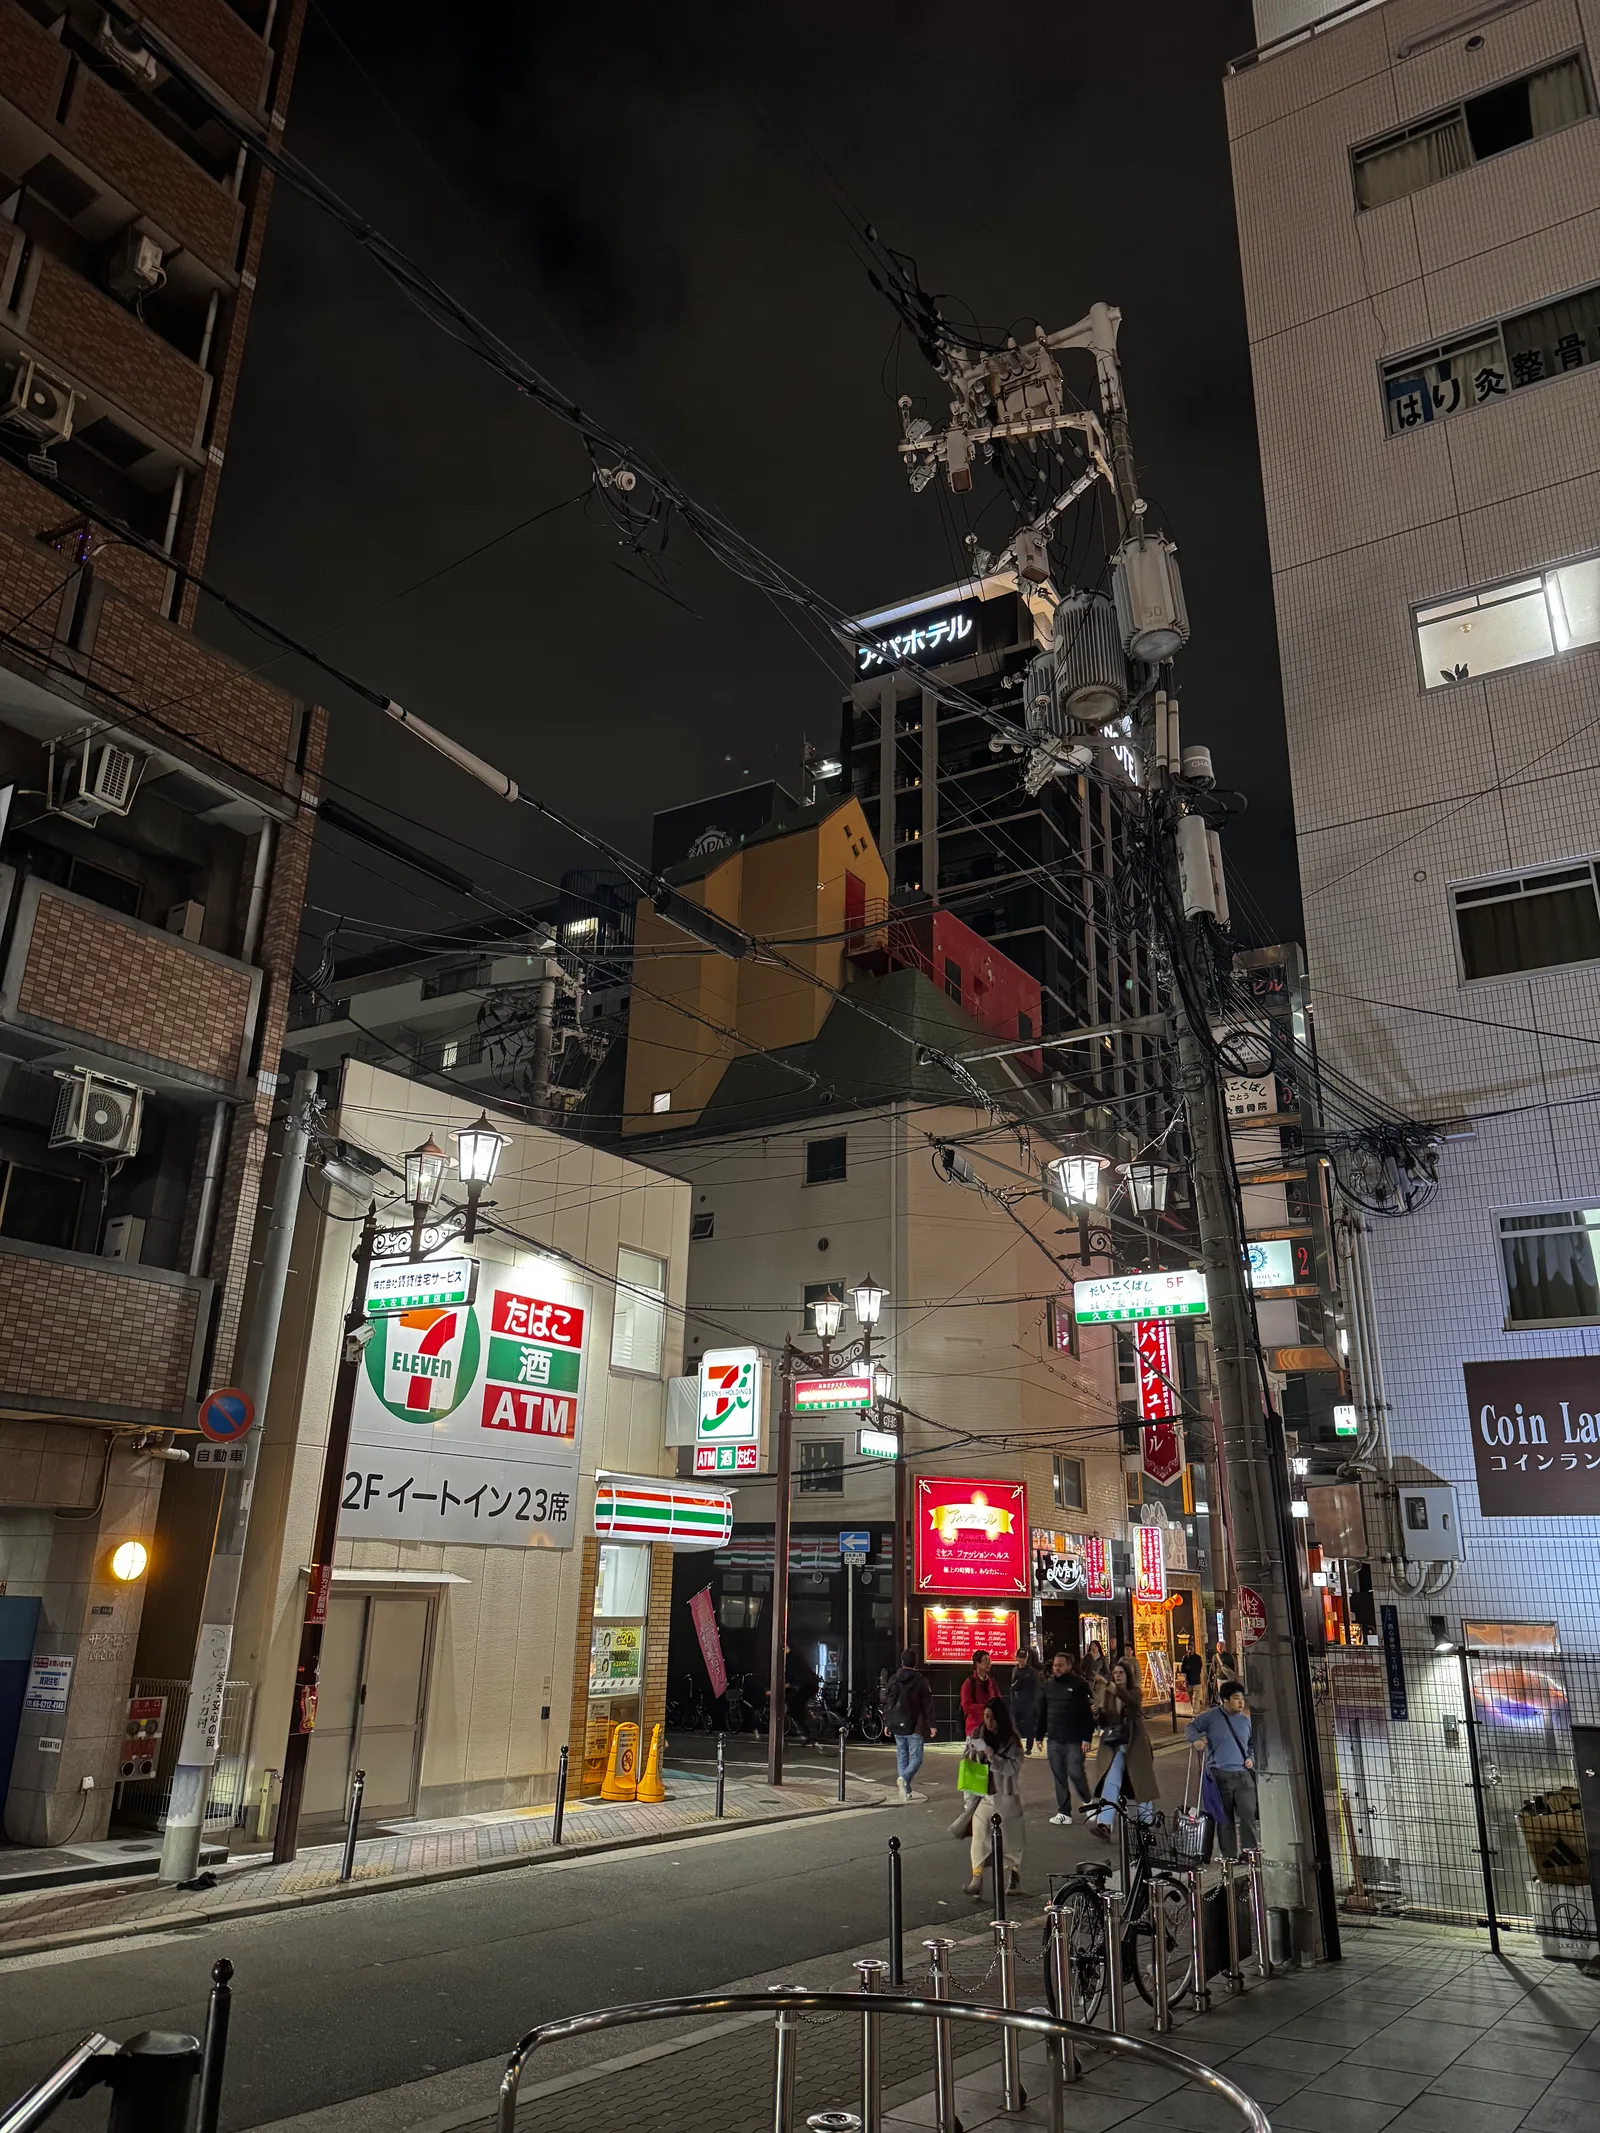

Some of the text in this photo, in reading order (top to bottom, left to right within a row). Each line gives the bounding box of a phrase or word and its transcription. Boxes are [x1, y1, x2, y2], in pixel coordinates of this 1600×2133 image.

[1397, 326, 1600, 429] はり灸整骨
[858, 614, 973, 670] アパホテル
[1297, 1247, 1309, 1276] 2
[1089, 1276, 1184, 1298] だいこくばし 5F
[504, 1298, 571, 1342] たばこ
[1092, 1304, 1190, 1321] 久左衛門商店街
[517, 1345, 553, 1385] 酒
[725, 1387, 752, 1396] HOLDINGS
[1139, 1321, 1164, 1454] バンチュール
[491, 1391, 570, 1435] ATM
[1480, 1403, 1548, 1446] Coin
[197, 1449, 244, 1463] 自動車
[698, 1448, 756, 1467] ATM 酒 たばこ
[1490, 1453, 1600, 1471] コインラン
[935, 1548, 1010, 1559] ミセス ファッションヘルス
[1393, 1677, 1400, 1687] 6
